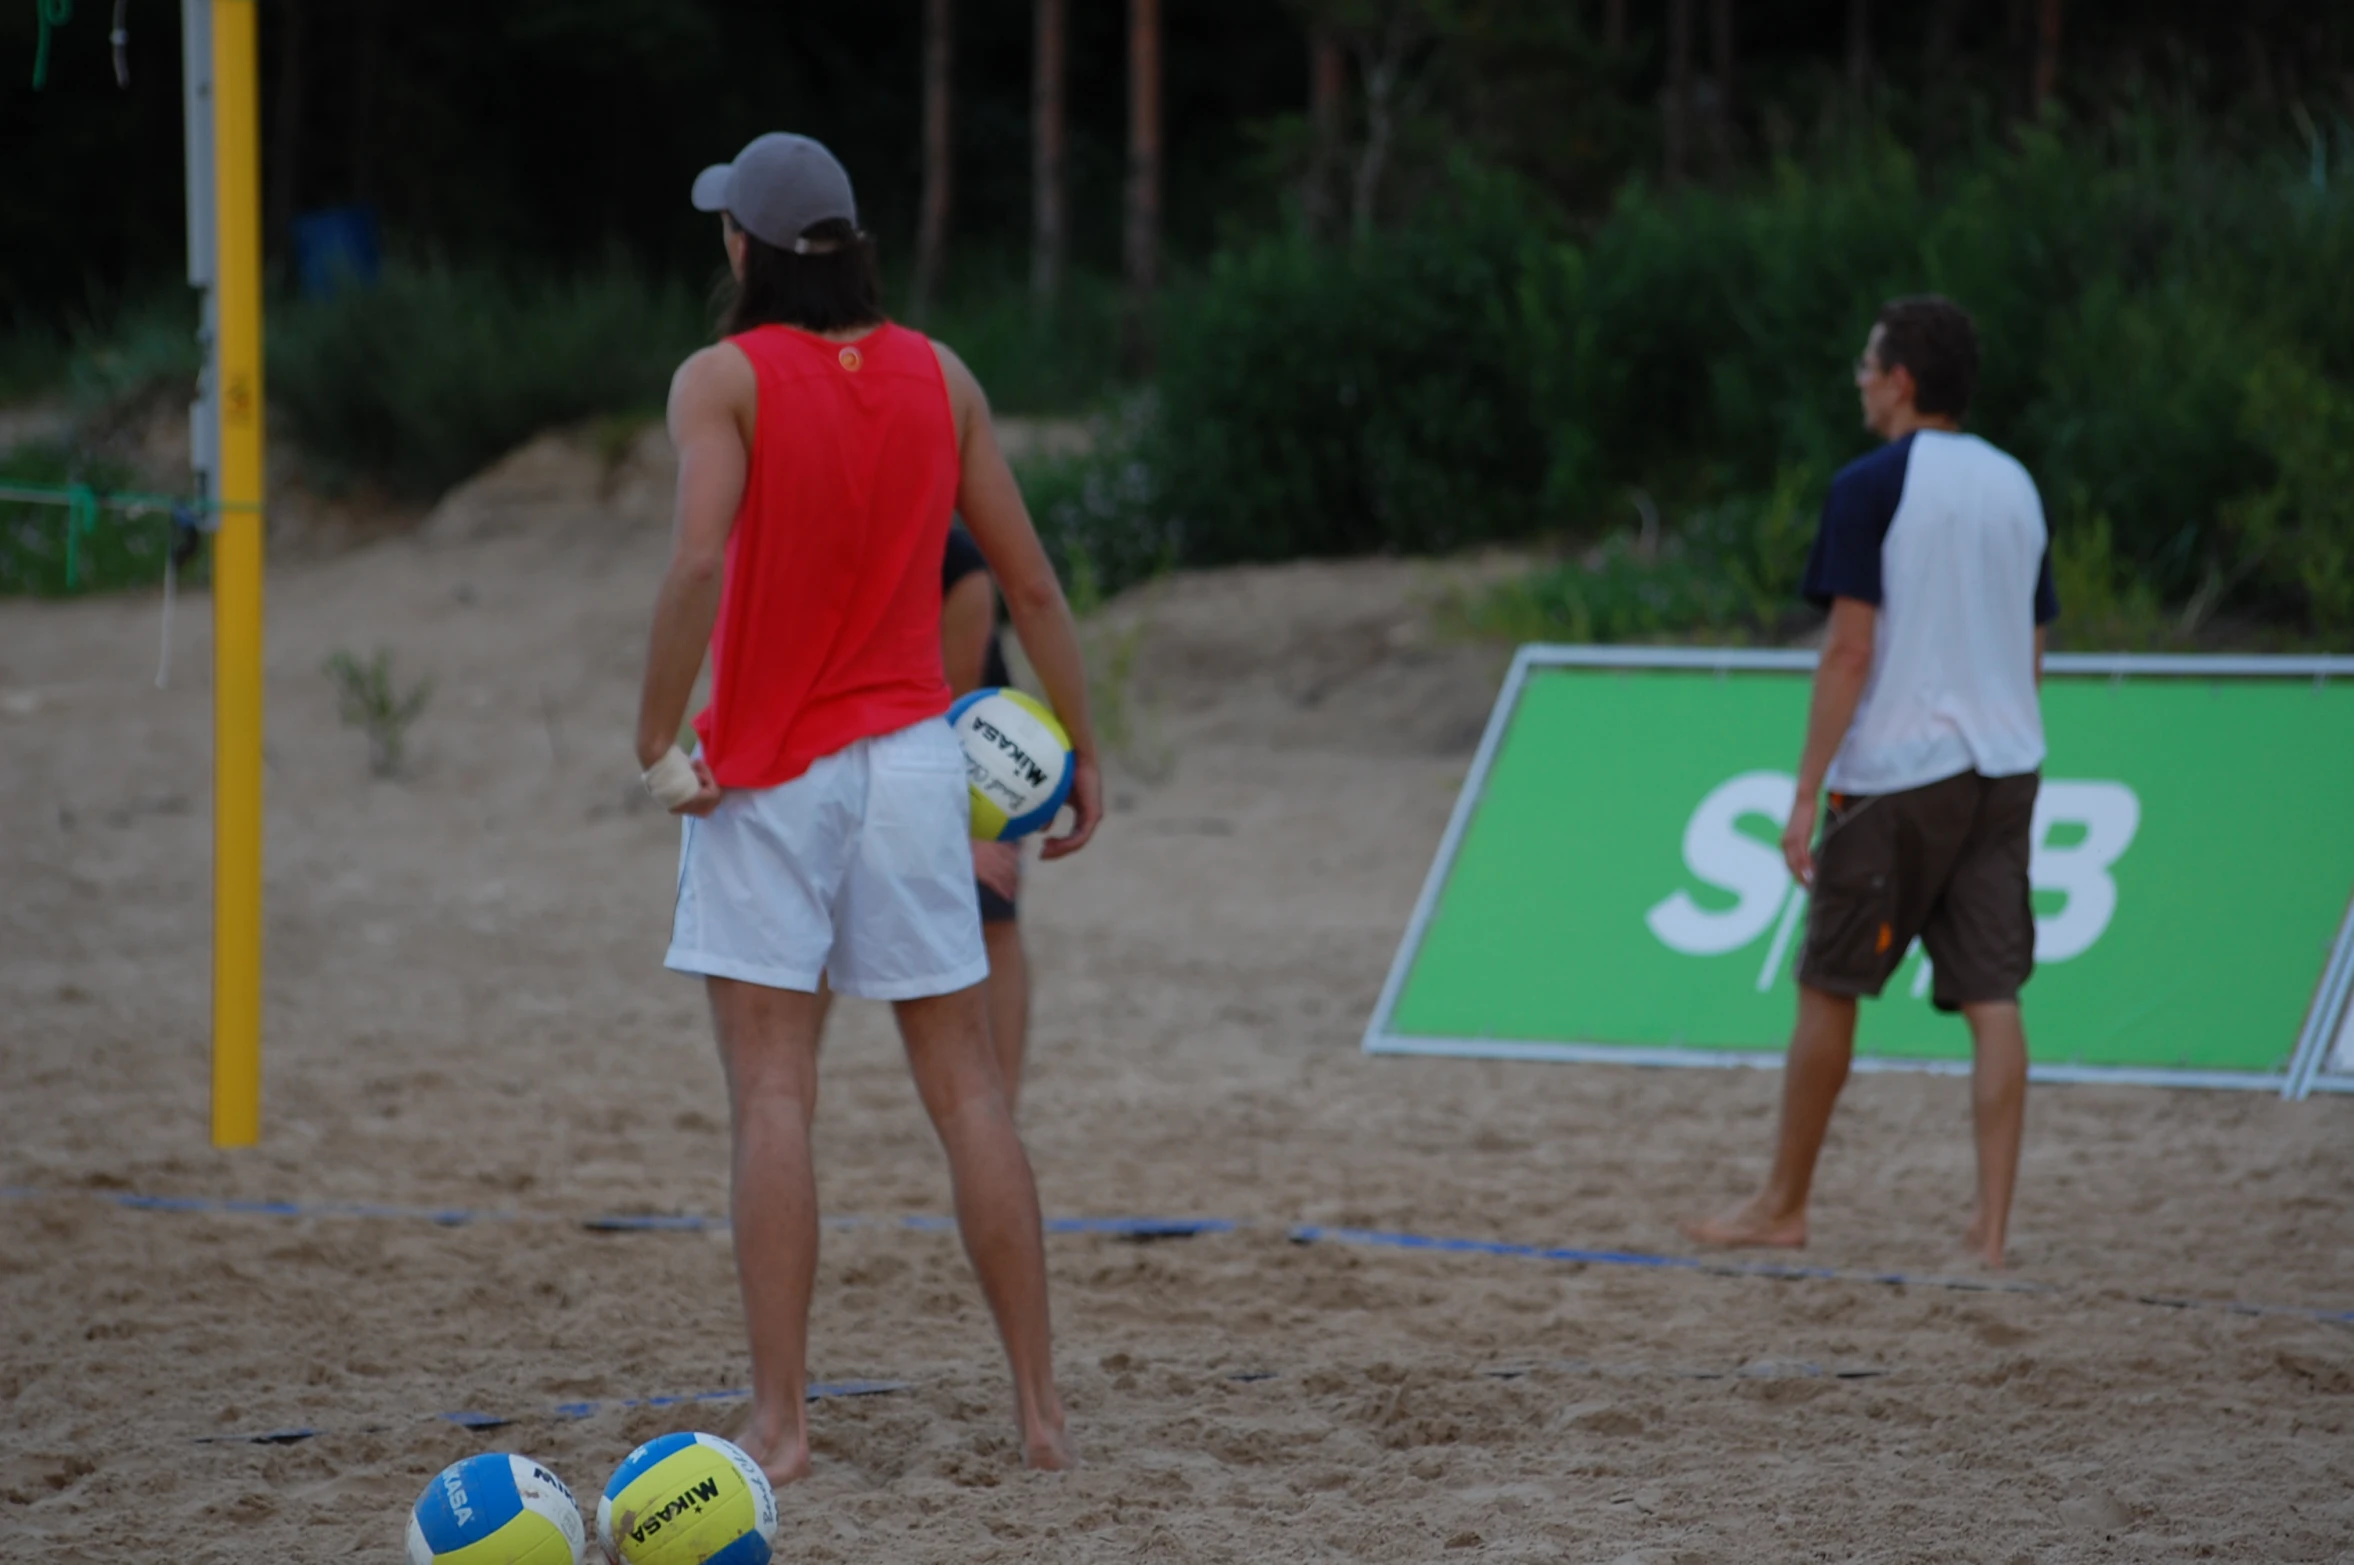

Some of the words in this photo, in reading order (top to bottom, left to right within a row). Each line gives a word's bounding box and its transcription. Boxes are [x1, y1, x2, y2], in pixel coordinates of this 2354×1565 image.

[972, 716, 1047, 787] MIKASA
[1644, 769, 2141, 965] SB
[631, 1477, 719, 1544] MIKASA
